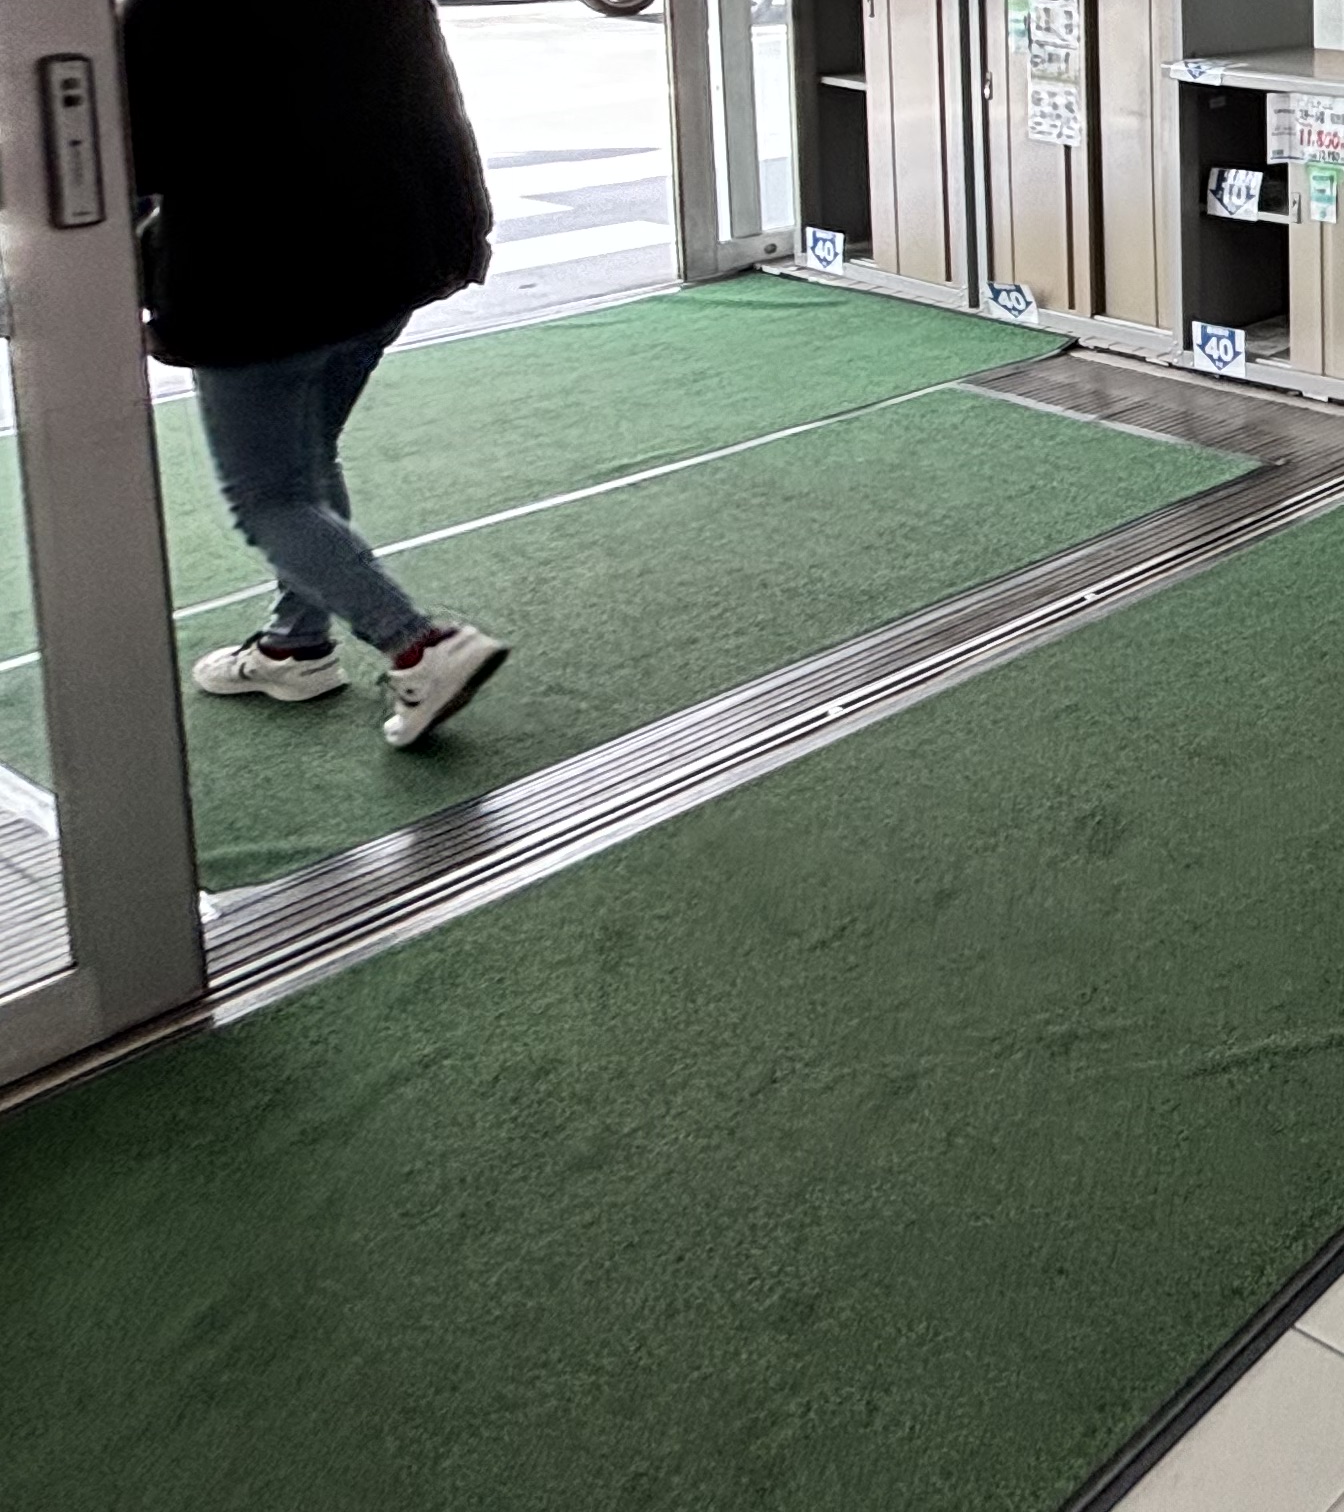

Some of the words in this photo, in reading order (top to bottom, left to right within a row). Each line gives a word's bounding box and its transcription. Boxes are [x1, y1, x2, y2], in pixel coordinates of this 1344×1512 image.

[814, 240, 834, 261] 40
[998, 289, 1027, 310] 40
[1204, 337, 1233, 363] 40
